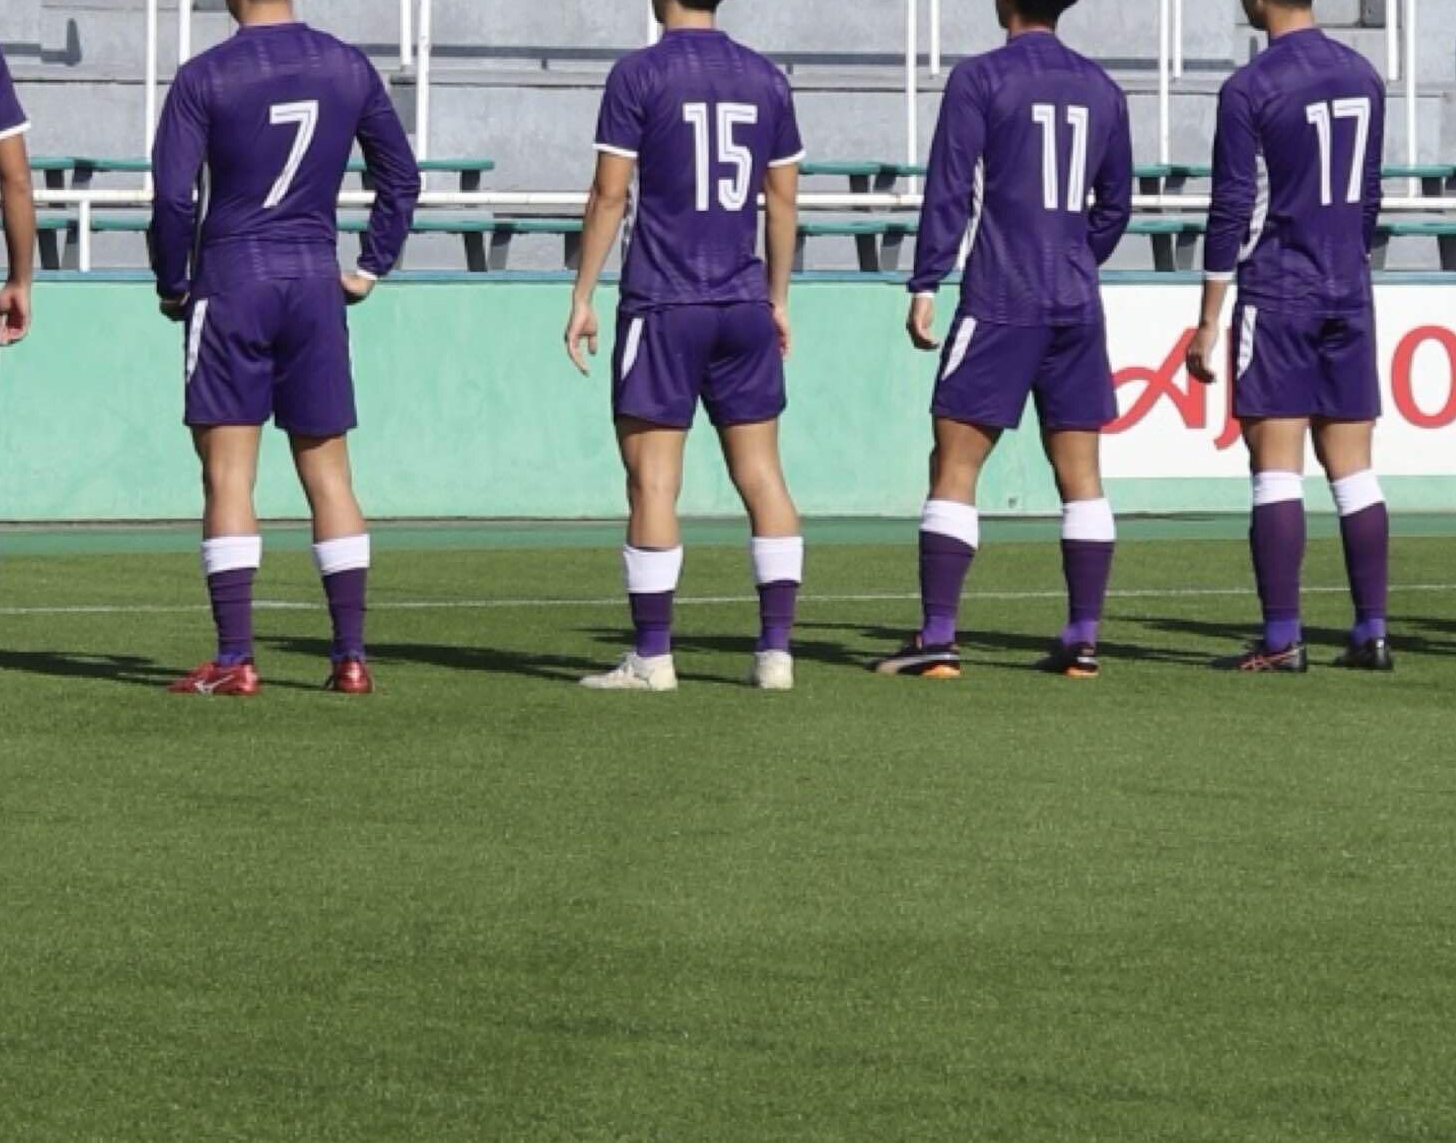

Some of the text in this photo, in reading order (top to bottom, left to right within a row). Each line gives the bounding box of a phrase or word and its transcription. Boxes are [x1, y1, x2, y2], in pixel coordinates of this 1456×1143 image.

[269, 99, 320, 209] 7
[682, 102, 758, 213] 15
[1031, 104, 1090, 213] 11
[1305, 97, 1372, 206] 17
